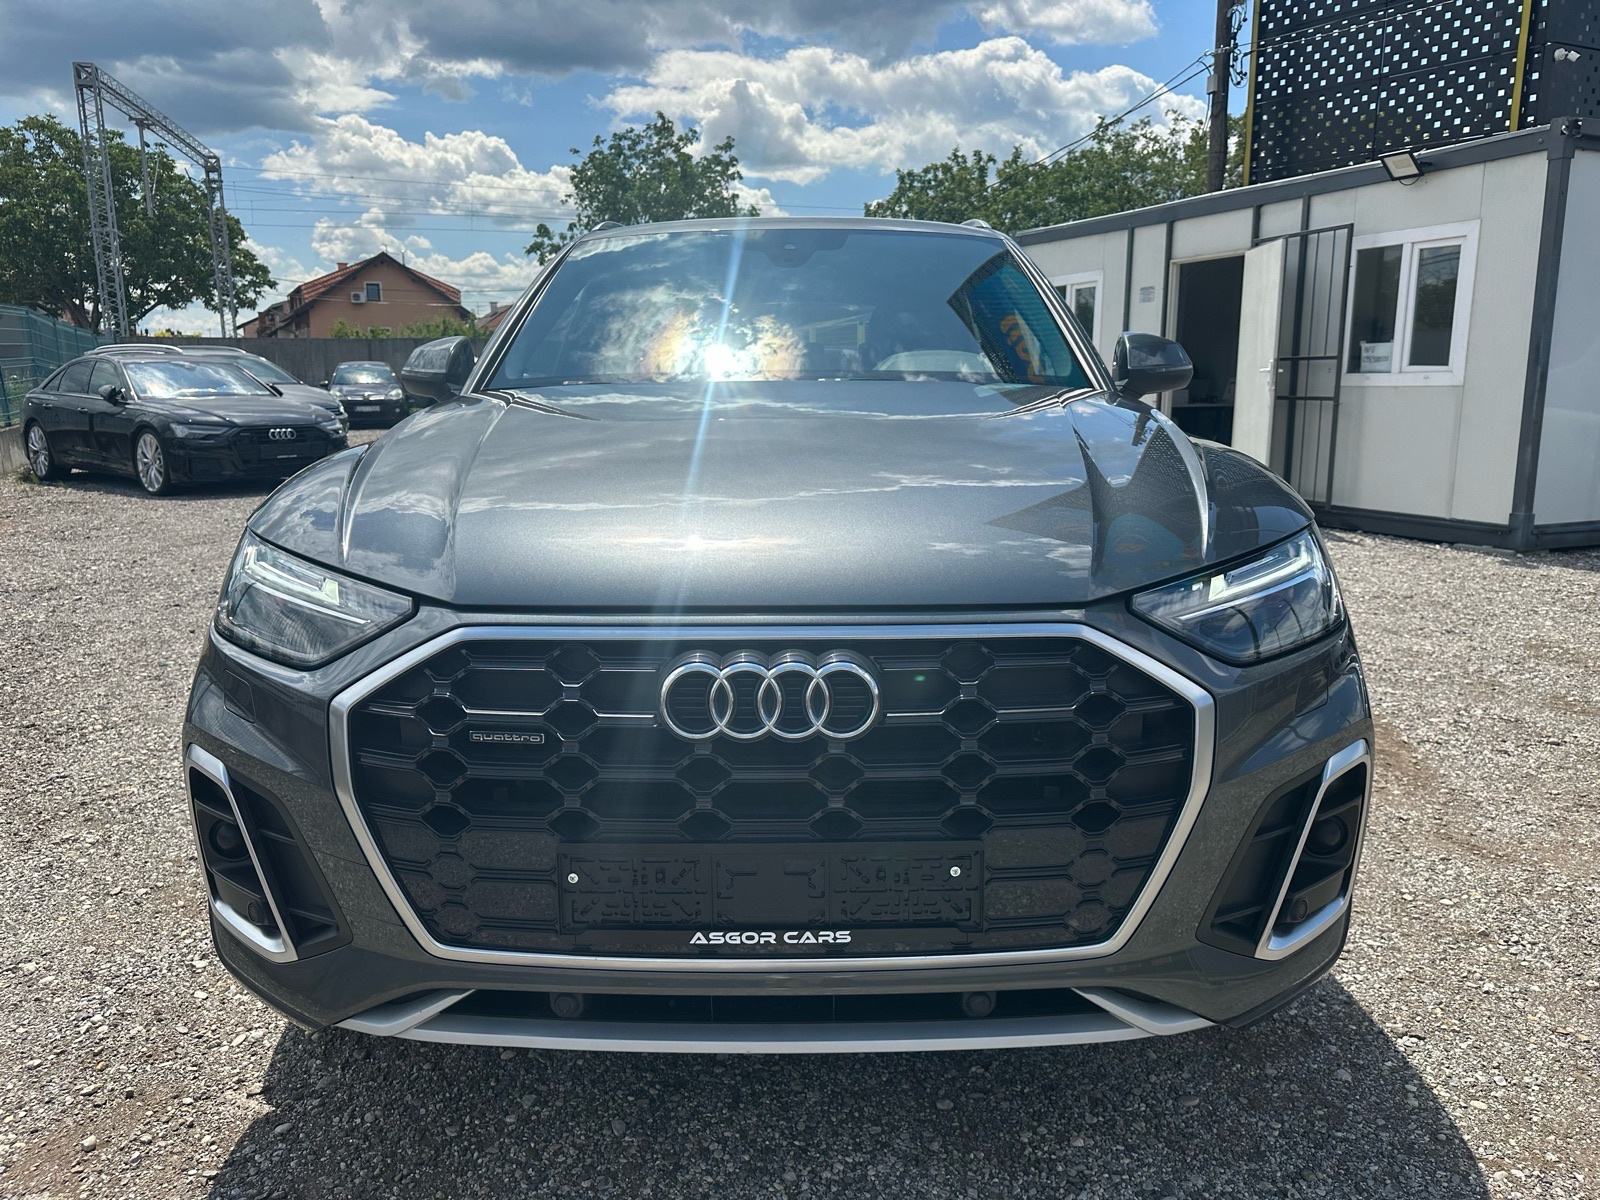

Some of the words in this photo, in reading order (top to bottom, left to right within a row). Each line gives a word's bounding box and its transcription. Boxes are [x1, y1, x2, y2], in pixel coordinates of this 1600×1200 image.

[472, 733, 541, 742] quattro
[689, 931, 777, 945] ASGOR
[783, 930, 852, 944] CARS
